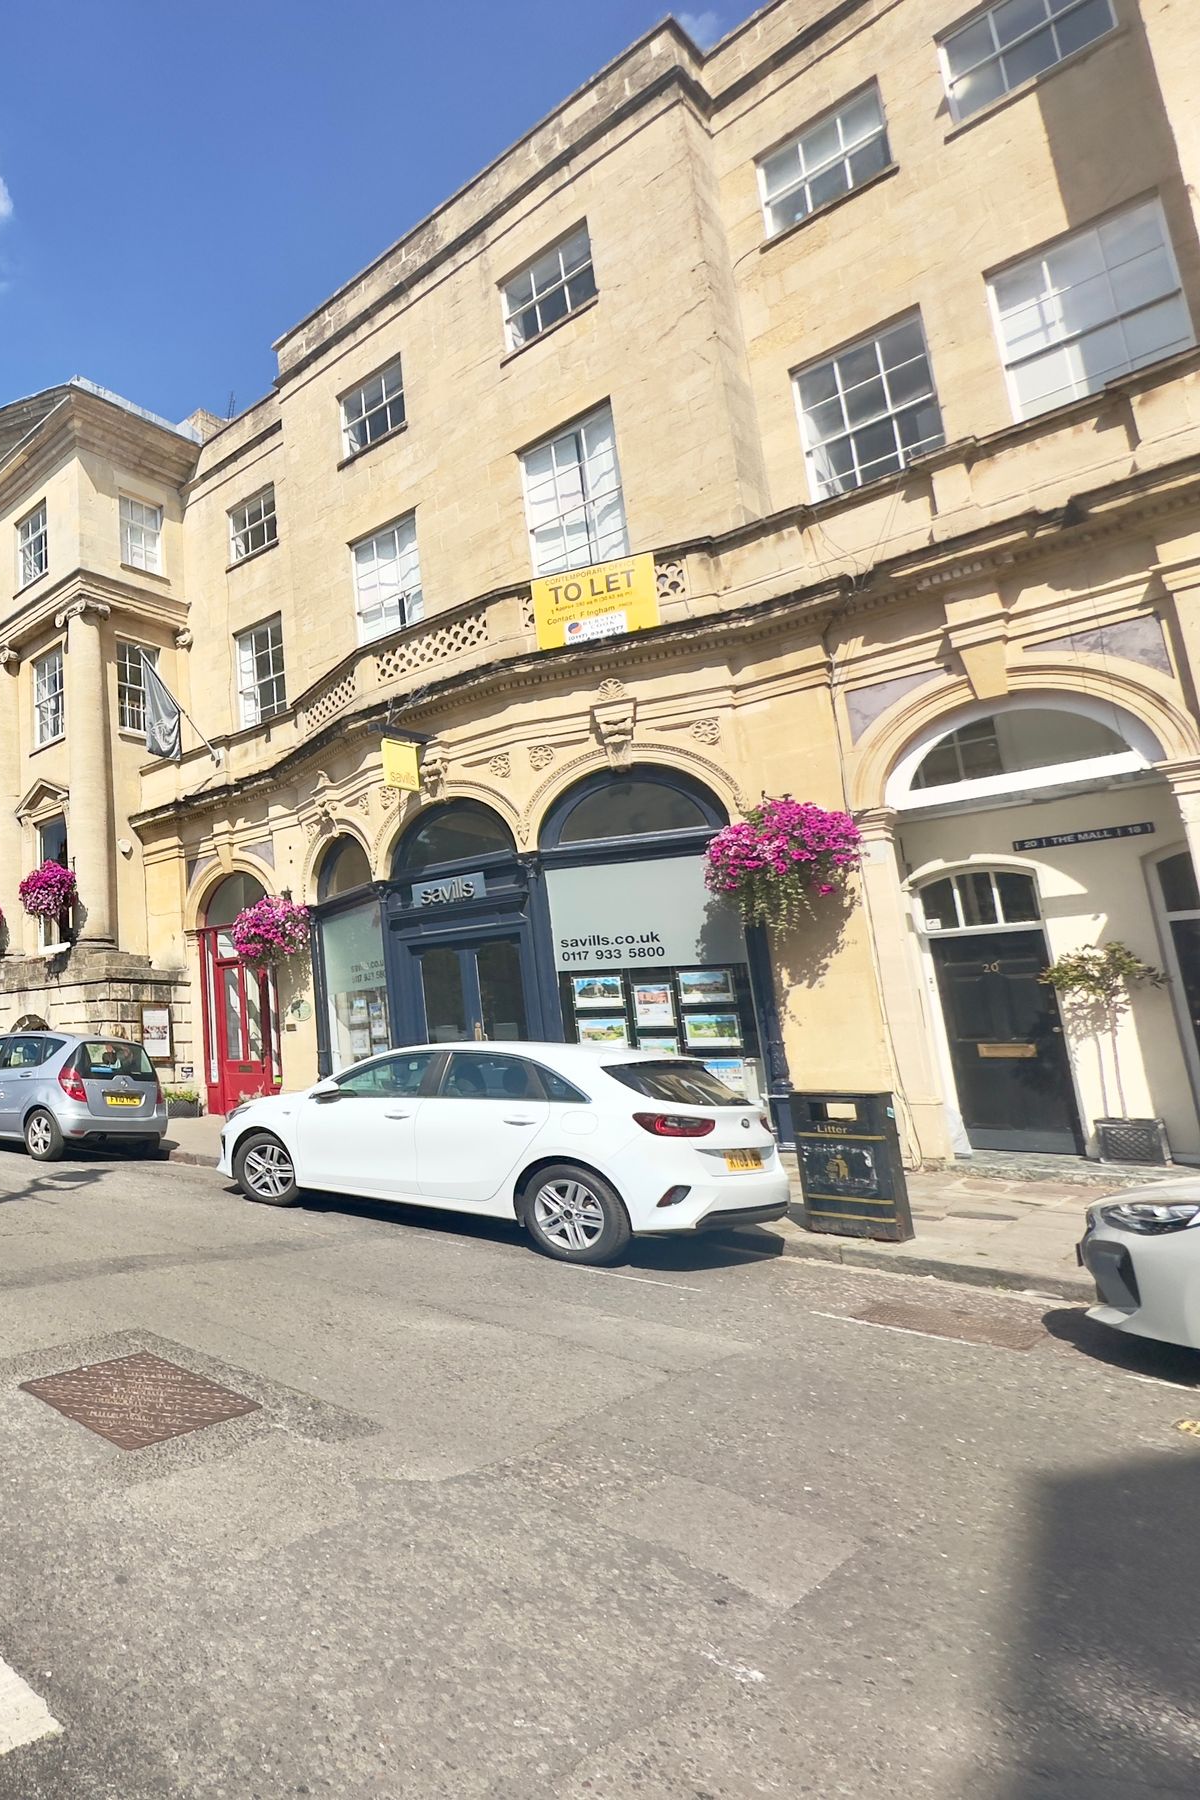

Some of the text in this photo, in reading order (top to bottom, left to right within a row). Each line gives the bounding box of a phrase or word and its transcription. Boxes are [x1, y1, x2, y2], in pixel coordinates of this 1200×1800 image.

[545, 567, 606, 586] CONTEMPORARY
[548, 569, 635, 605] TO LET
[547, 613, 576, 625] Contact
[587, 605, 616, 617] Ingham
[1051, 835, 1074, 844] THE
[1077, 831, 1112, 842] MALL
[420, 878, 475, 905] savills
[560, 931, 661, 949] savills.co.uk
[561, 946, 665, 962] 0117 933 5800
[982, 961, 1000, 974] 20
[817, 1125, 847, 1133] Litter
